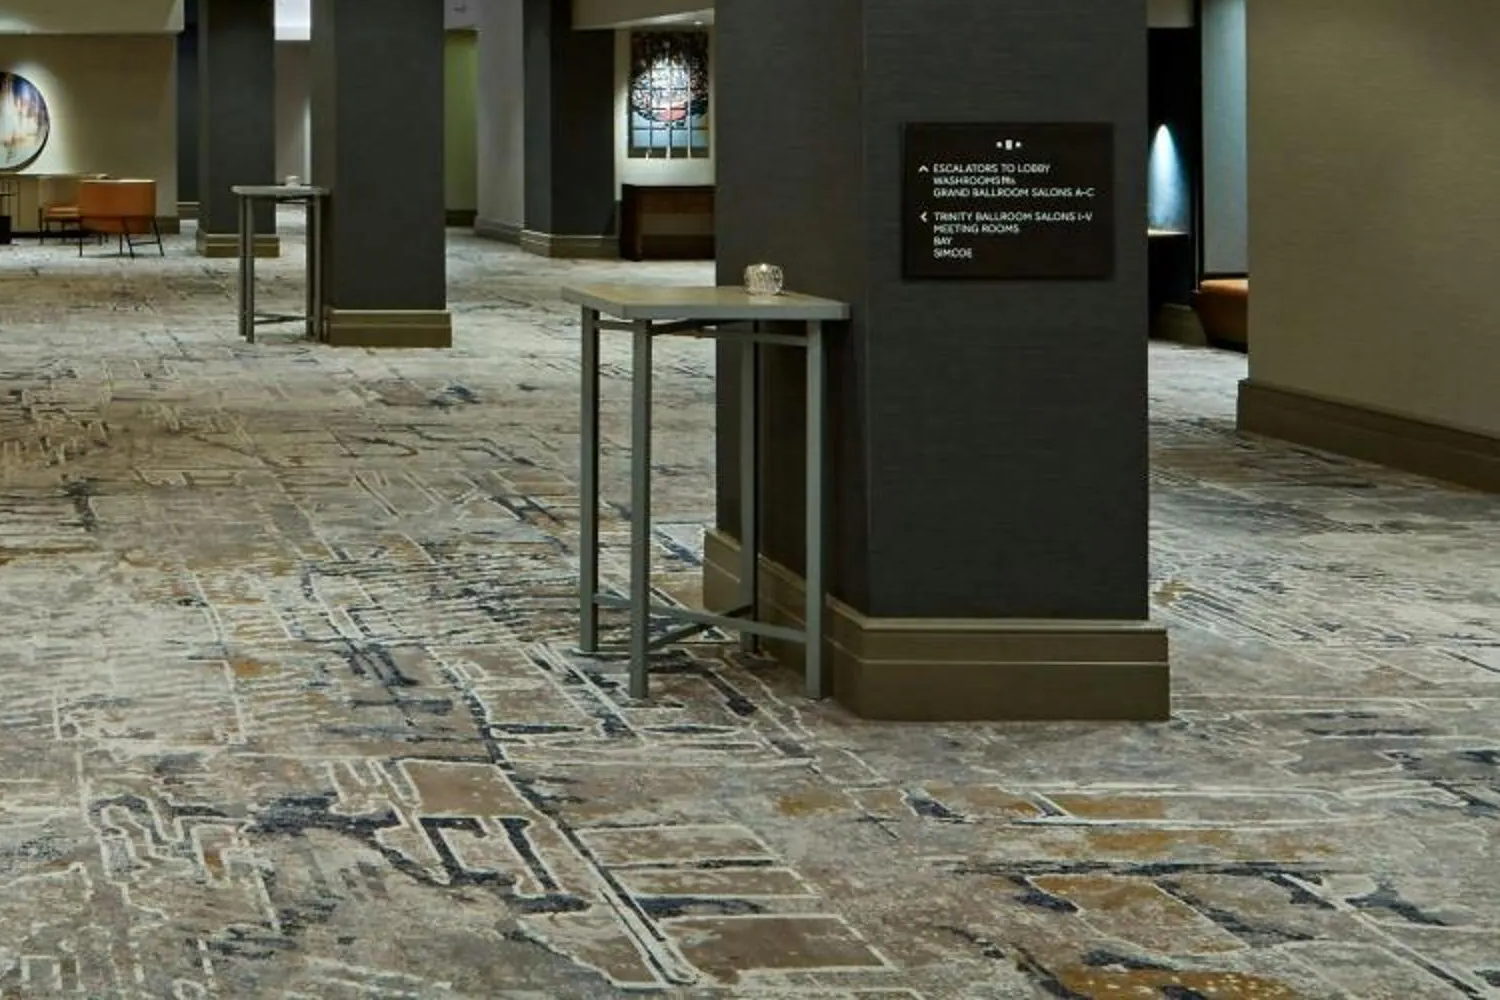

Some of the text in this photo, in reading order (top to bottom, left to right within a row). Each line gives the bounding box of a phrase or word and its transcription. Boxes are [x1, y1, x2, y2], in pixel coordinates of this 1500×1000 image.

[934, 164, 1050, 173] ESCALATORS TO LOBBY
[934, 188, 970, 197] GRAND
[972, 188, 1028, 197] BALLROOM
[1032, 188, 1072, 197] SALONS
[934, 212, 972, 221] TRINITY
[976, 212, 1032, 221] BALLROOM
[1035, 212, 1075, 221] SALONS
[934, 224, 1019, 233] MEETING ROOMS
[934, 237, 952, 245] BAY
[934, 248, 972, 258] SIMCOE
